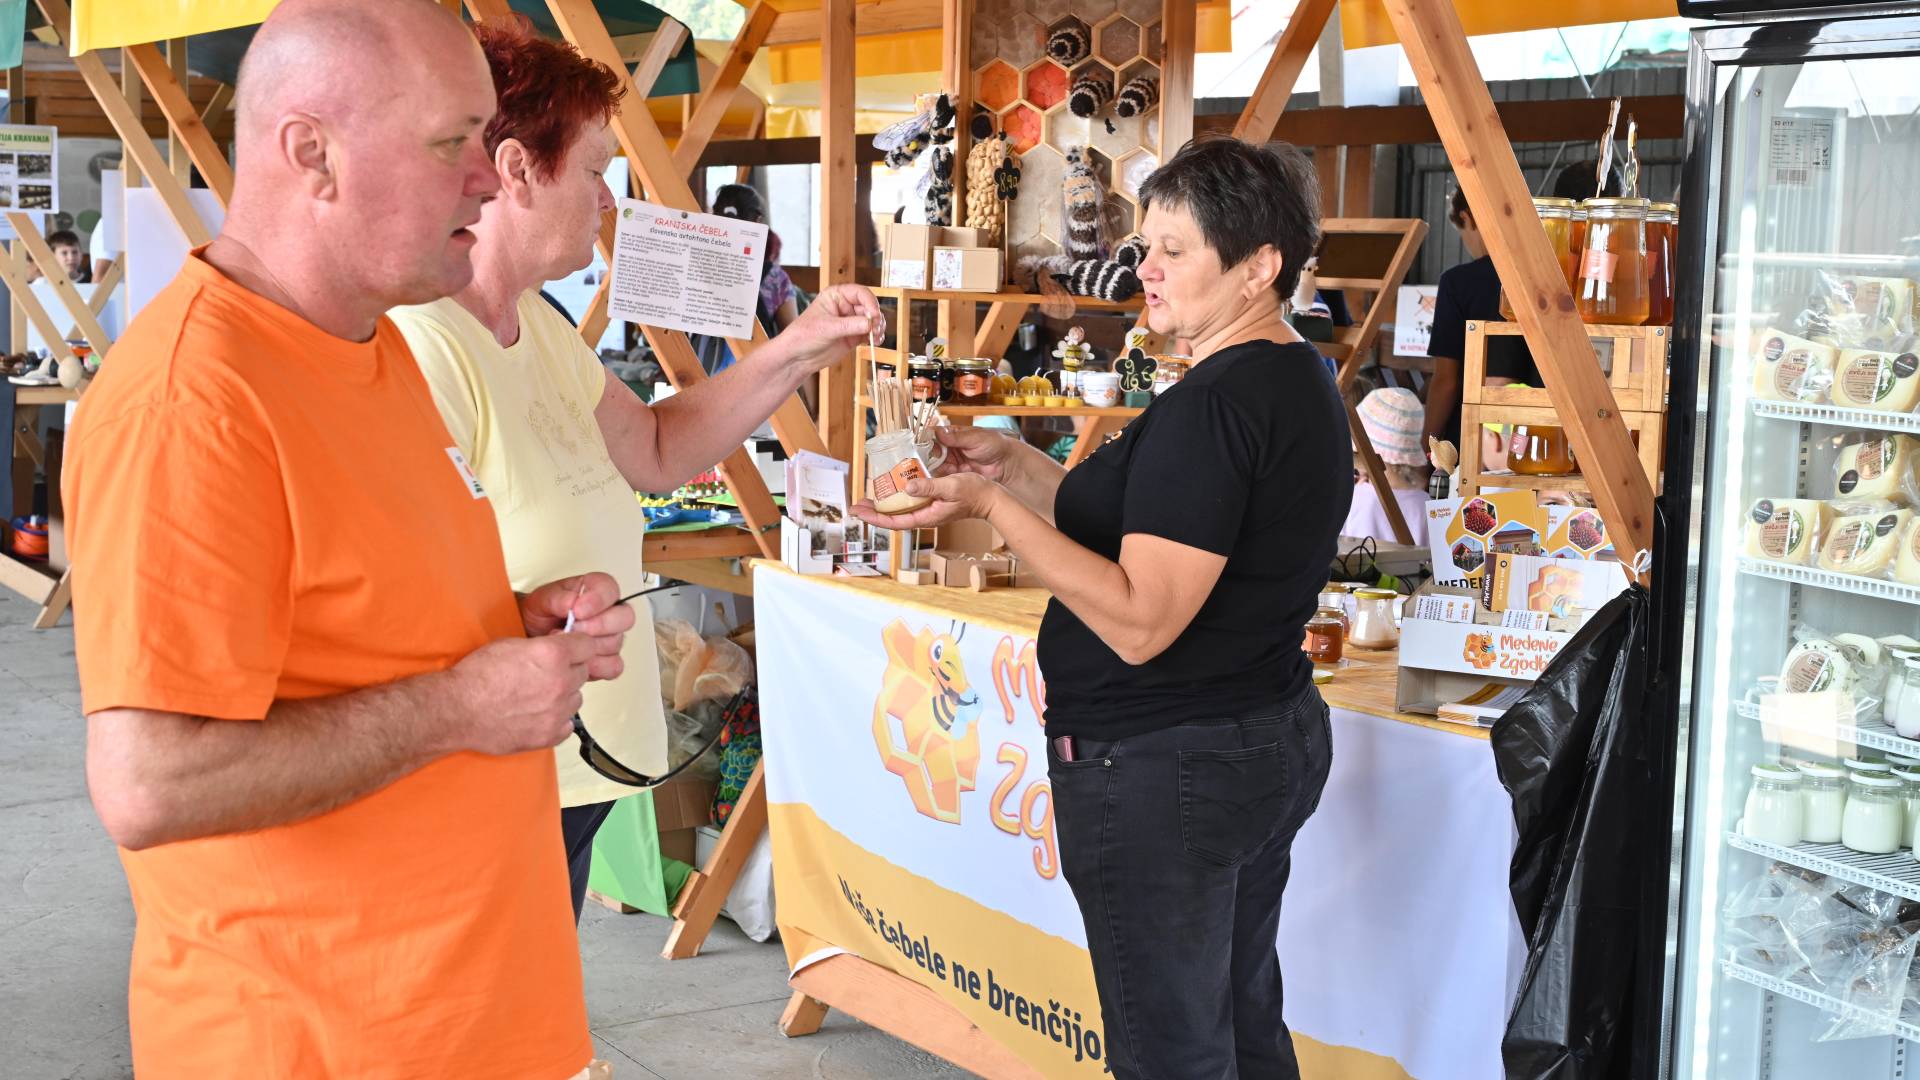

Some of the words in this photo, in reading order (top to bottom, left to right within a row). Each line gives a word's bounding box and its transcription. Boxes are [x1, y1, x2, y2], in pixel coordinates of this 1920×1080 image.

[650, 227, 678, 239] slovenska
[679, 231, 710, 245] avtohtona
[711, 236, 732, 248] čebela
[654, 217, 697, 232] KRANJSKA
[699, 223, 729, 238] ČEBELA
[1500, 634, 1558, 651] Medene
[1499, 652, 1549, 675] Zgodb
[992, 635, 1047, 727] M
[990, 741, 1058, 881] Zg
[877, 908, 947, 981] čebele
[952, 960, 981, 1000] ne
